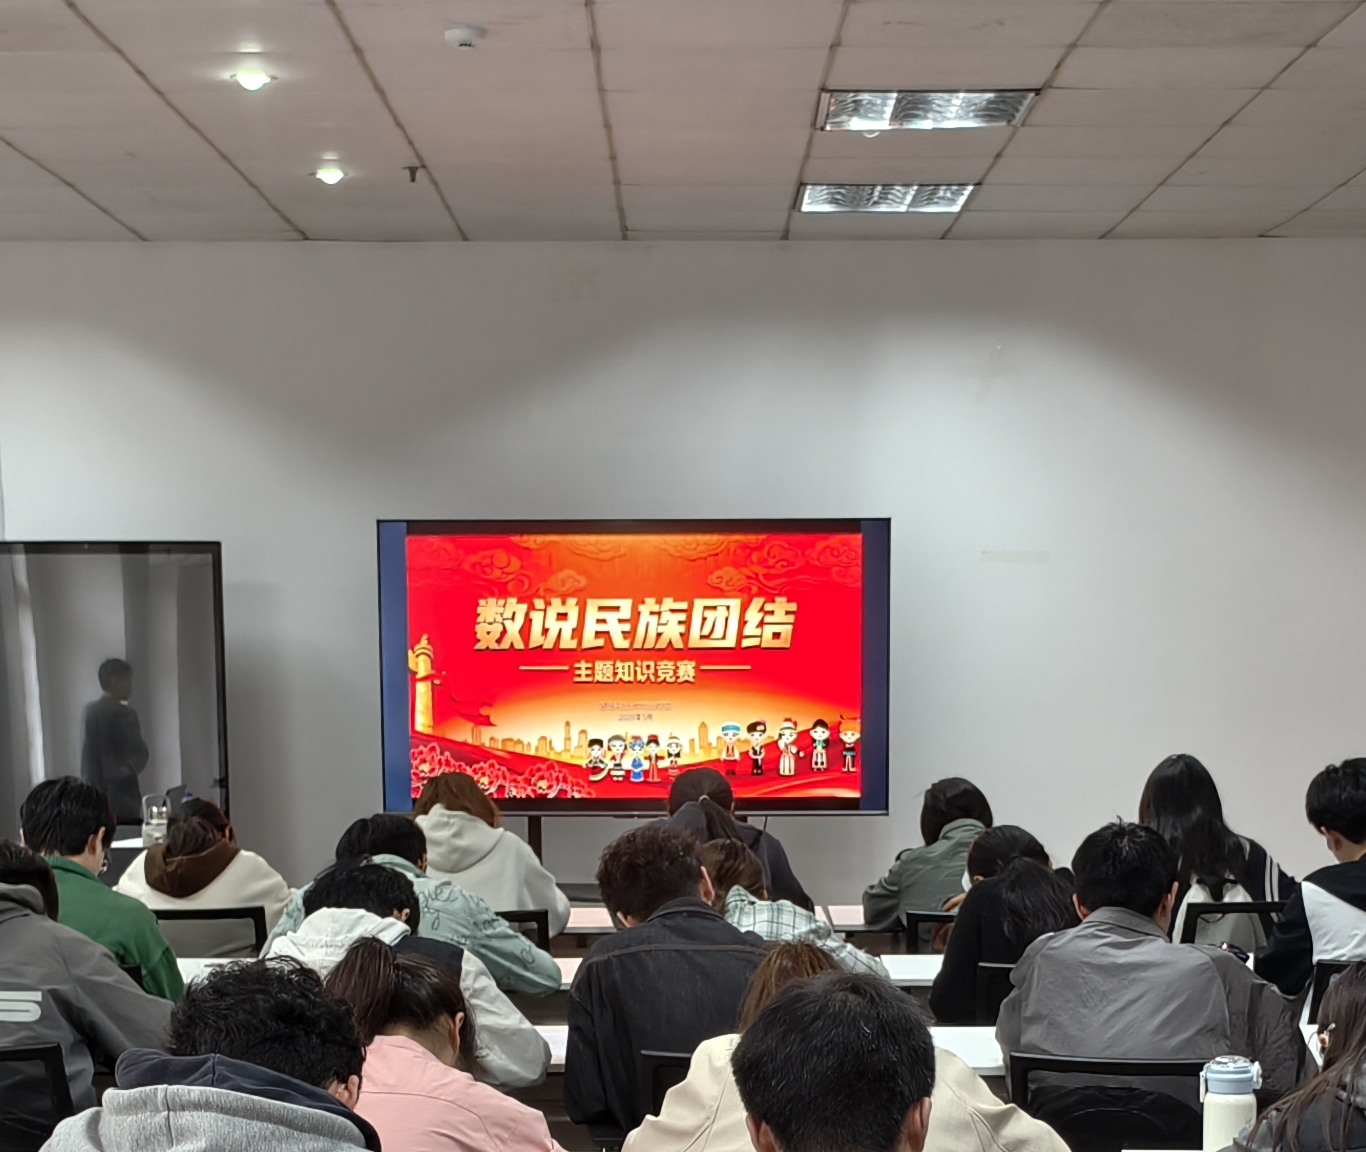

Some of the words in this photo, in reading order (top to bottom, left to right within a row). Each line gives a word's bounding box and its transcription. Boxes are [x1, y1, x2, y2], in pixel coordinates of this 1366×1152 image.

[473, 597, 798, 650] 数说民族团结
[573, 659, 697, 684] 主题知识竞赛
